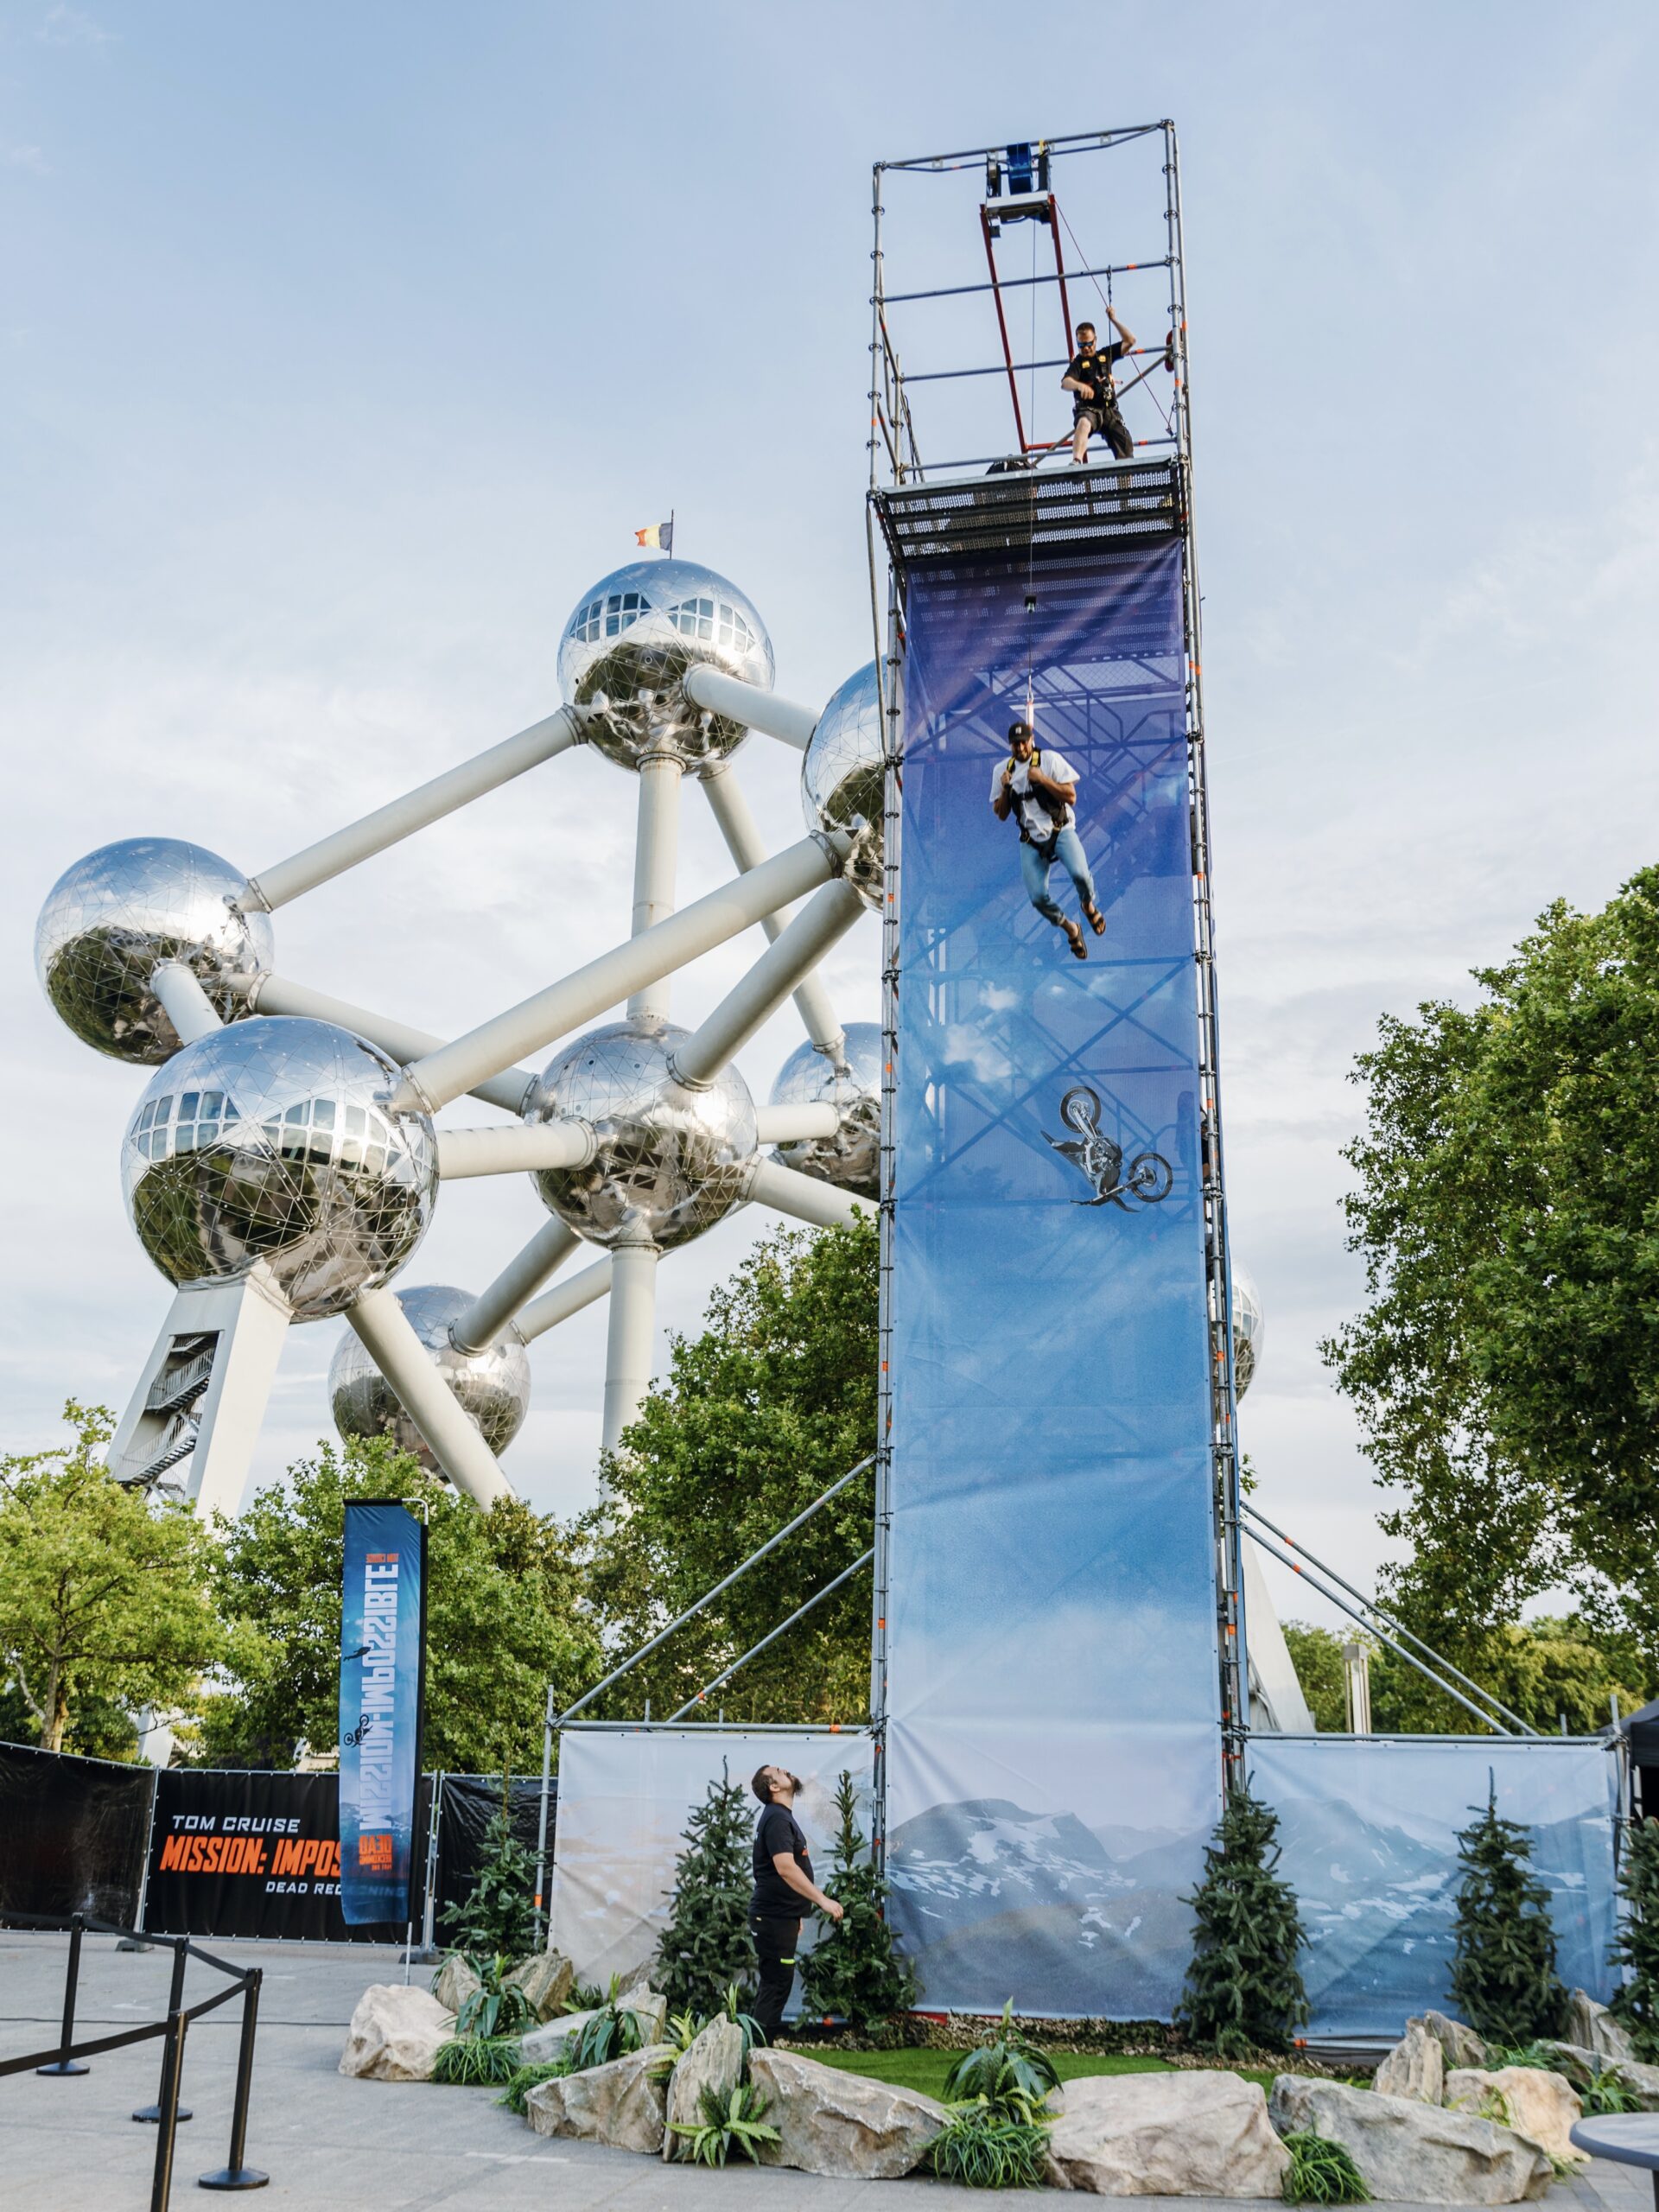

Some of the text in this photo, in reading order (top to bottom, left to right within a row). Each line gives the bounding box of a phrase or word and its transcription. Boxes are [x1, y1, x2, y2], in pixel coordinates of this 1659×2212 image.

[173, 1815, 300, 1834] TOM CRUISE
[159, 1834, 340, 1877] MISSION: IMPOS
[265, 1881, 308, 1894] DEAD
